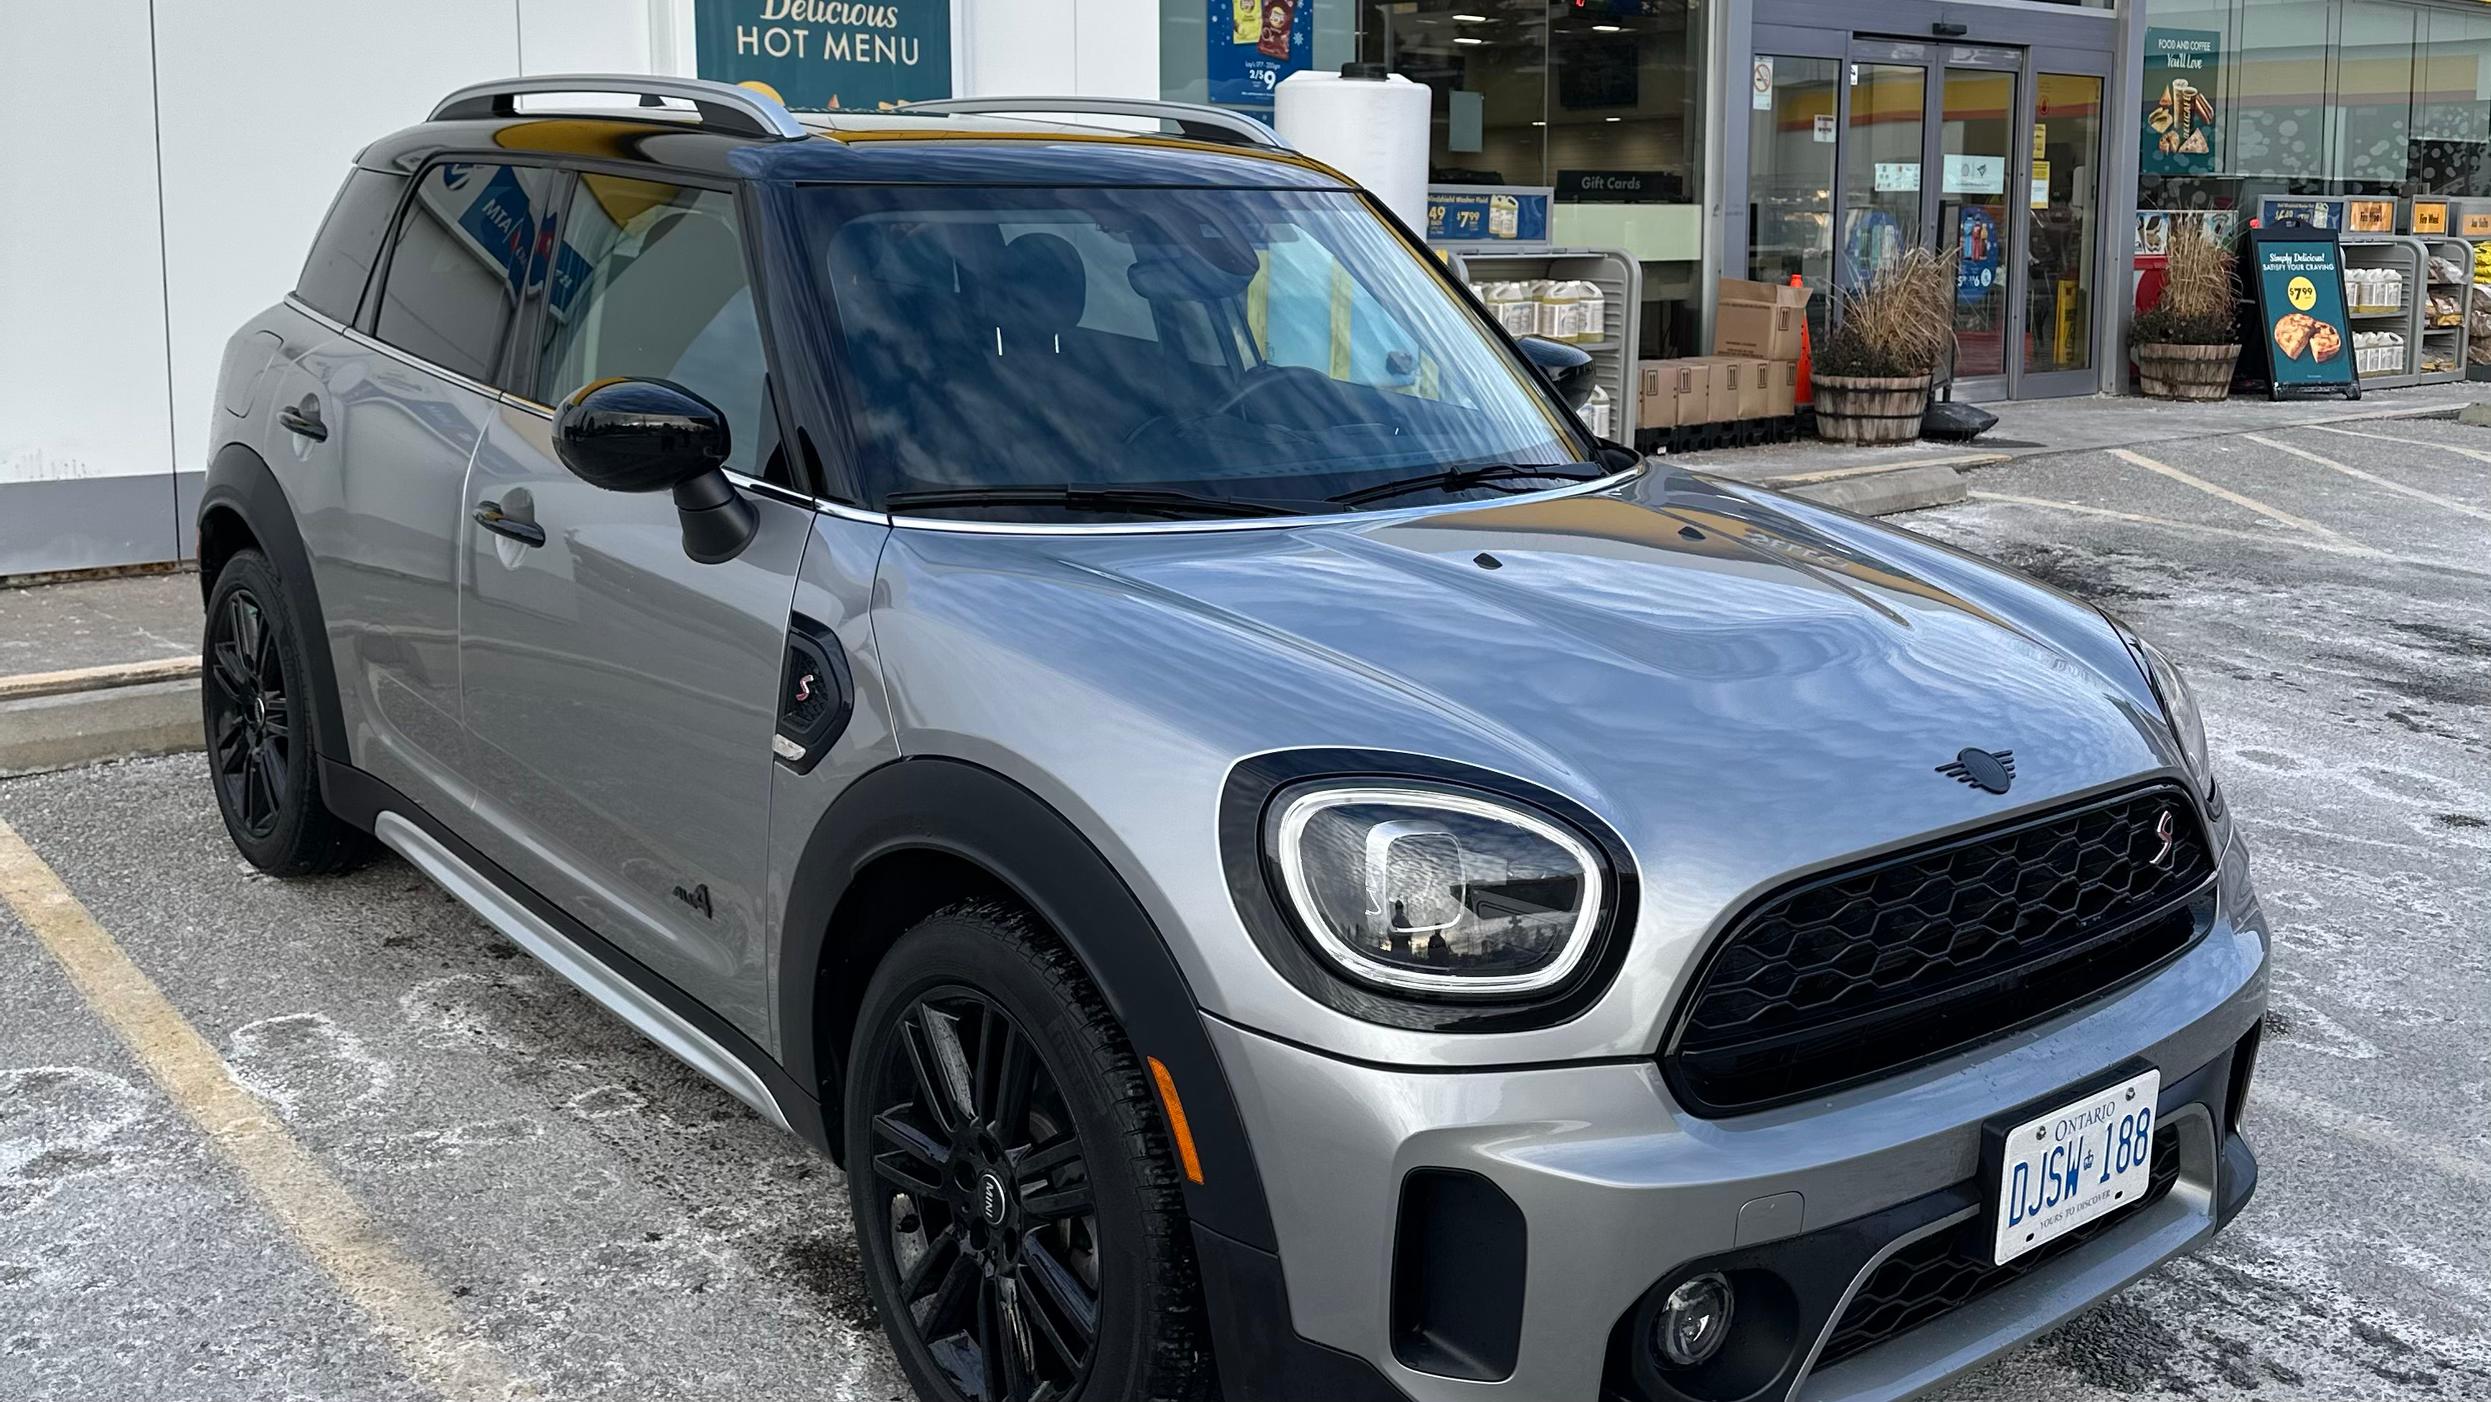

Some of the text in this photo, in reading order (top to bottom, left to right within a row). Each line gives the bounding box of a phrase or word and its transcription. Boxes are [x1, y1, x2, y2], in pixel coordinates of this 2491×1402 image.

[760, 0, 898, 28] Delicious
[736, 25, 919, 66] HOT MENU
[2158, 39, 2211, 51] FOOD AND COFFEE
[2187, 54, 2203, 69] Love
[1581, 176, 1641, 189] Gift Cards
[2262, 263, 2286, 271] SATISFY
[2269, 253, 2292, 264] Simply
[796, 674, 814, 701] S
[2055, 1101, 2116, 1142] ONTARIO
[2008, 1107, 2151, 1229] DJSW 188
[985, 1182, 994, 1218] MINI
[2040, 1189, 2111, 1230] YOURS TO DISCOVER
